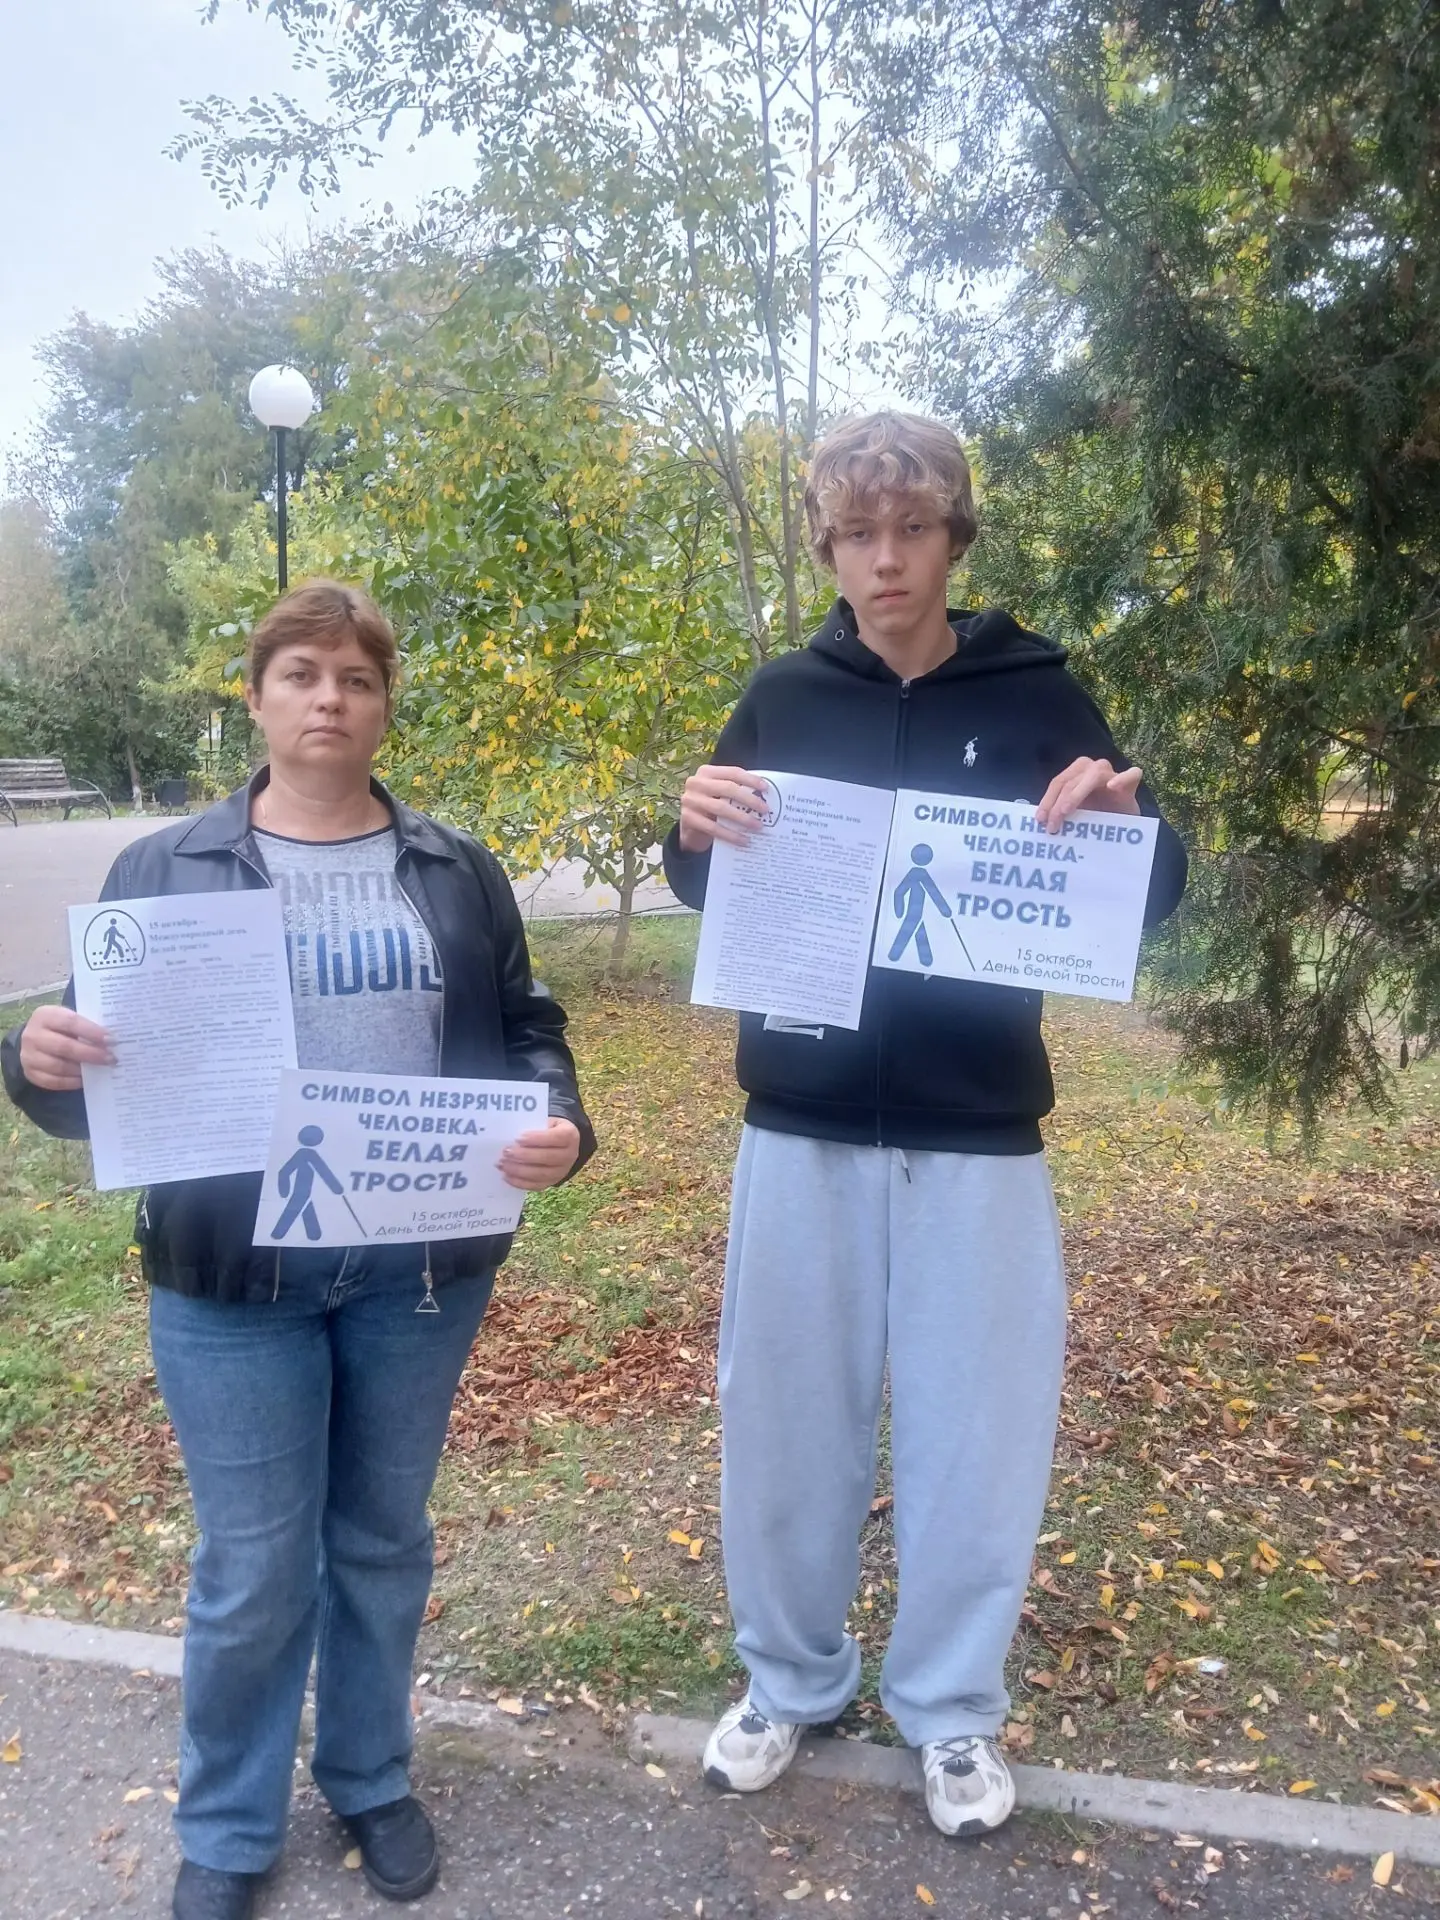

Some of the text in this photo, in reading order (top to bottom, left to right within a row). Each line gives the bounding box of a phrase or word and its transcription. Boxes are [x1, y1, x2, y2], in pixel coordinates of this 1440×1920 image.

[913, 804, 1144, 845] СИМВОЛ НЕРЯЧЕГО
[963, 834, 1085, 863] ЧЕЛОВЕКА-
[970, 860, 1069, 893] БЕЛАЯ
[956, 892, 1073, 930] ТРОСТЬ
[1016, 947, 1093, 970] 15 октября
[981, 959, 1126, 989] День белой трости
[301, 1083, 538, 1113] СИМВОЛ НЕЗРЯЧЕГО
[357, 1112, 486, 1137] ЧЕЛОВЕКА-
[366, 1139, 469, 1163] БЕЛАЯ
[349, 1171, 469, 1193] ТРОСТЬ
[374, 1217, 513, 1238] День белой трости
[411, 1206, 485, 1222] 15 октября
